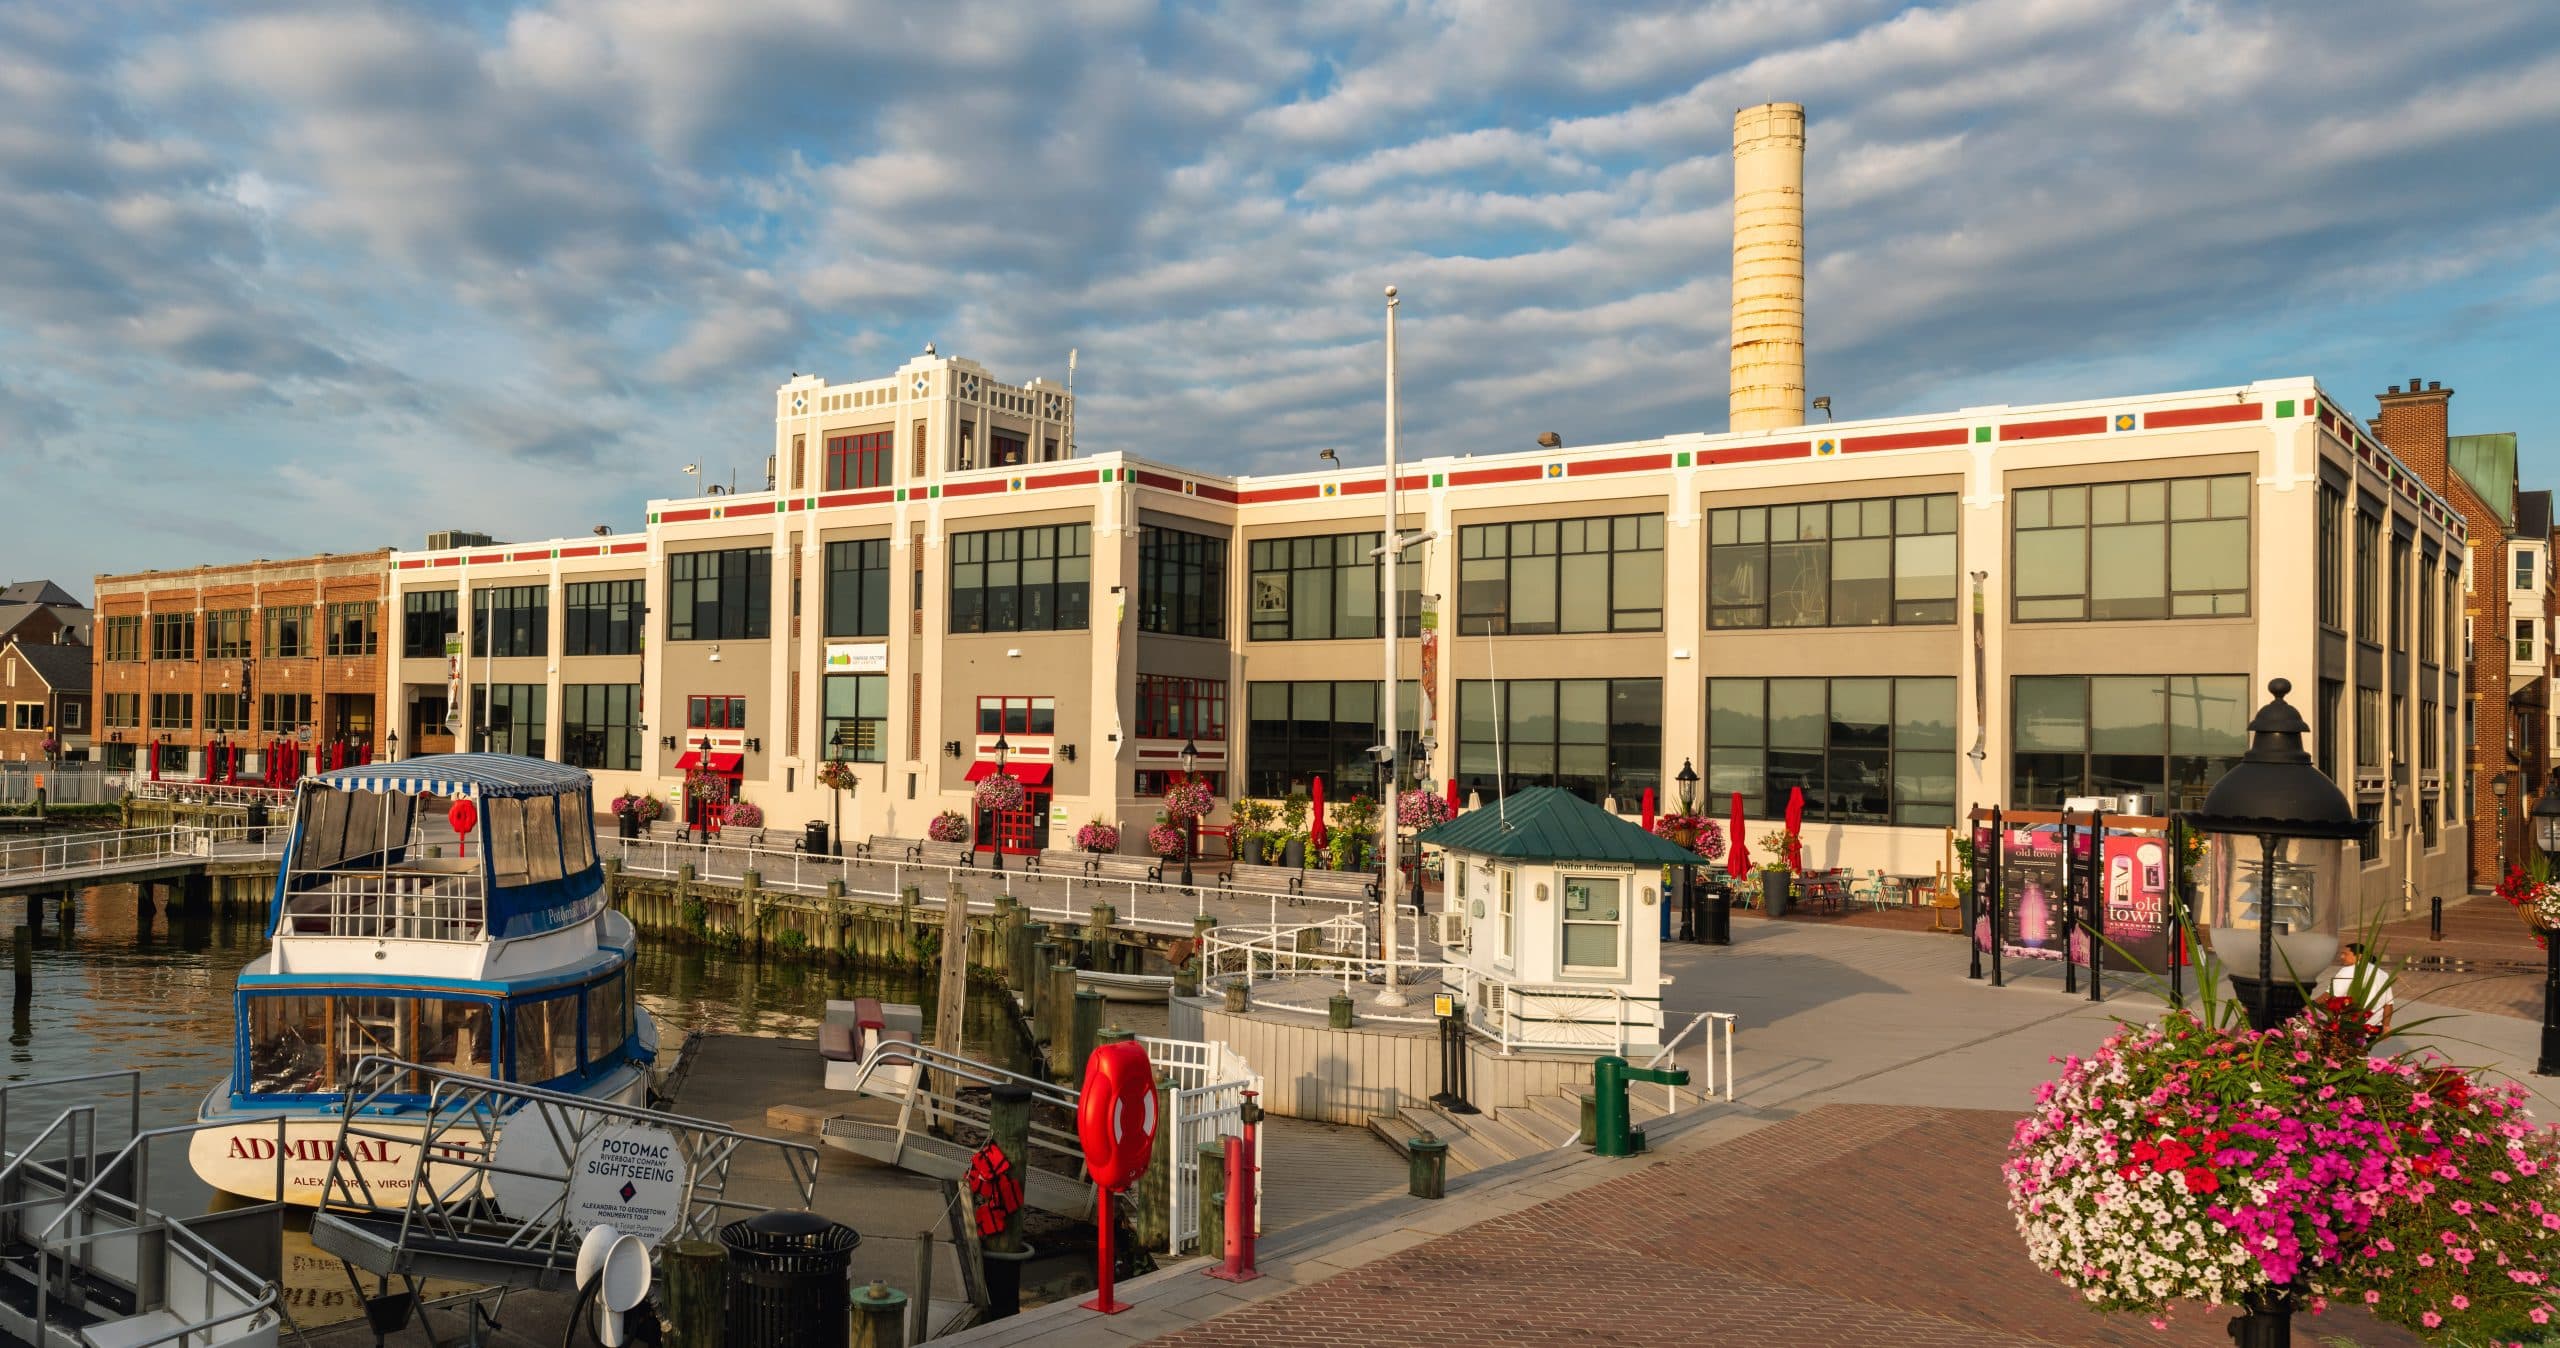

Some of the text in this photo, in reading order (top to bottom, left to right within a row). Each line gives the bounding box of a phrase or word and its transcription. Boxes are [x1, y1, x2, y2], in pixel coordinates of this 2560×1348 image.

[2015, 848, 2030, 857] old
[2033, 850, 2057, 858] town
[1556, 862, 1633, 872] Visitor Information
[2135, 897, 2162, 912] old
[2109, 905, 2163, 924] town
[602, 1139, 669, 1159] POTOMAC
[600, 1153, 667, 1167] RIVERBOAT COMPANY
[588, 1161, 674, 1182] SIGHTSEEING
[582, 1202, 618, 1211] ALEXANDRIA
[627, 1206, 667, 1216] GEORGETOWN
[597, 1211, 649, 1221] MONUMENTS TOUR
